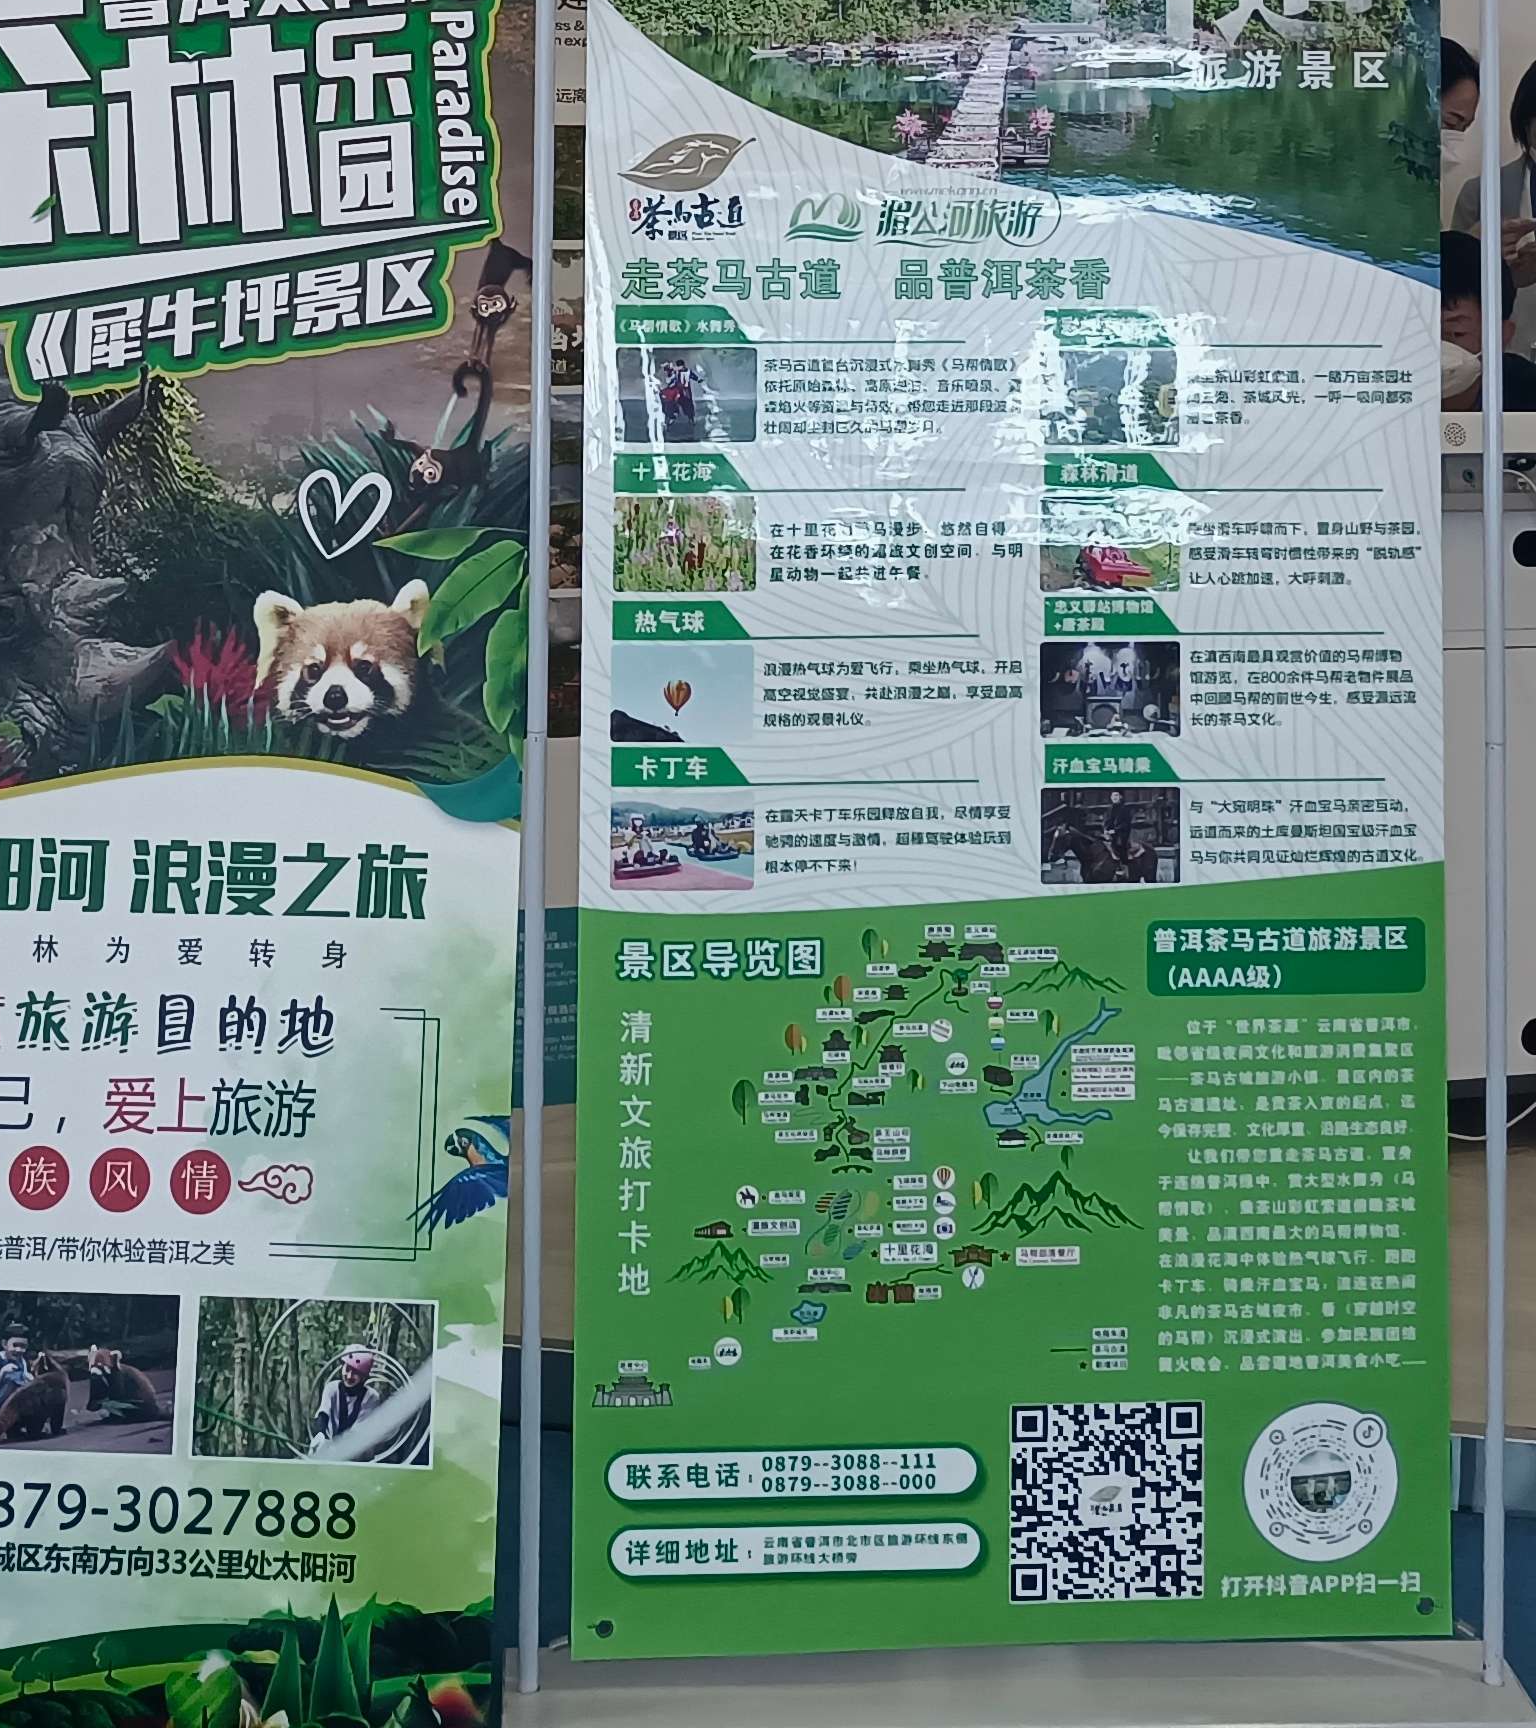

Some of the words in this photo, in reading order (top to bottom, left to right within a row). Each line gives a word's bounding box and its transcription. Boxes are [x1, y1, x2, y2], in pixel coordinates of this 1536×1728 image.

[1189, 51, 1389, 91] 旅游景区
[431, 12, 486, 216] Paradise
[876, 199, 1044, 238] 湄公河旅游
[622, 258, 841, 299] 走茶马古道
[895, 258, 1110, 299] 品普洱茶香
[1061, 464, 1138, 483] 森林滑道
[635, 611, 704, 633] 热气球
[635, 756, 708, 780] 卡丁车
[131, 838, 428, 919] 浪漫之旅
[1154, 926, 1408, 953] 普洱茶马古道旅游景区
[618, 940, 823, 979] 景区导览图
[618, 1010, 652, 1296] 清新文旅打卡地
[884, 1244, 934, 1257] 十里花海
[1221, 1572, 1421, 1598] 打开抖音APP扫一扫
